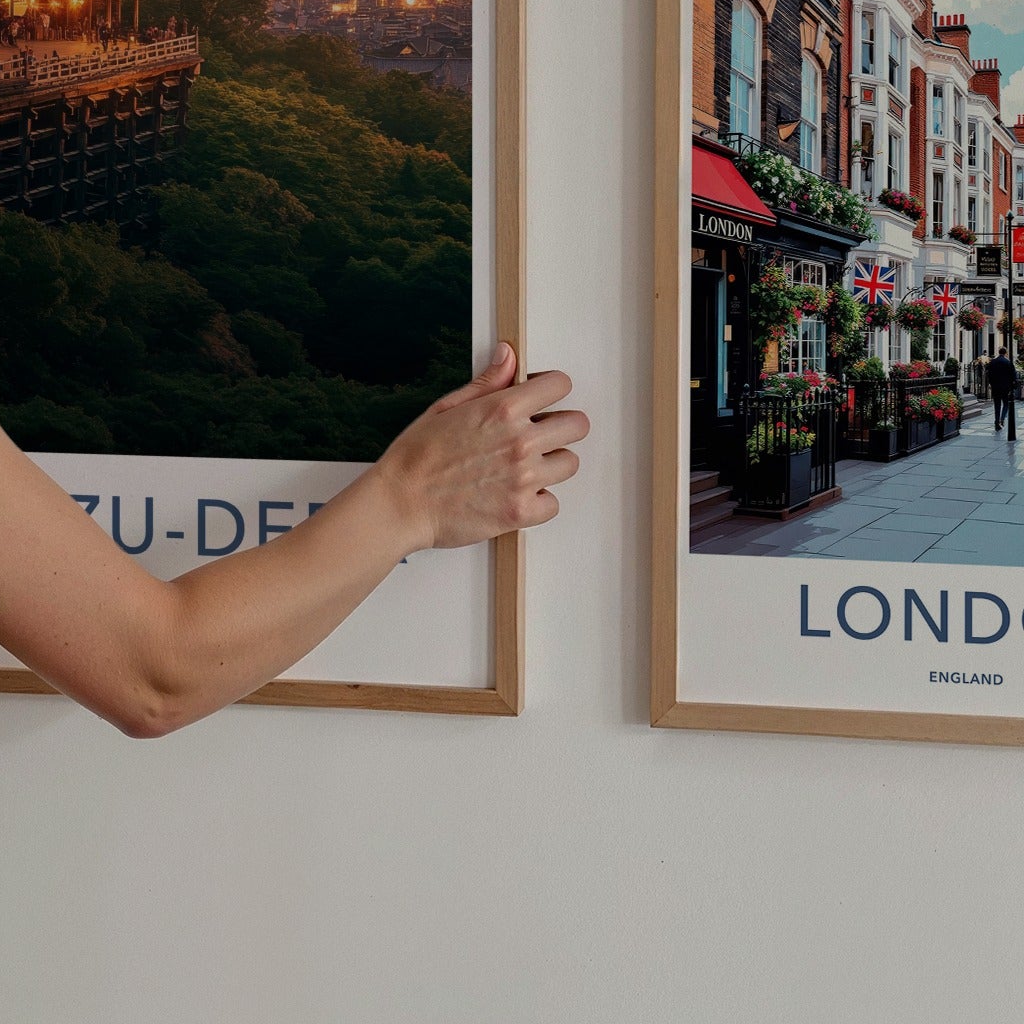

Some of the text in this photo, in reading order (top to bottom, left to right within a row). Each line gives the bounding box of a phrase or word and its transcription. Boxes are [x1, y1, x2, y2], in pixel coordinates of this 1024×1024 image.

[698, 213, 753, 242] LONDON
[800, 584, 1024, 645] LOND
[929, 671, 1004, 686] ENGLAND
